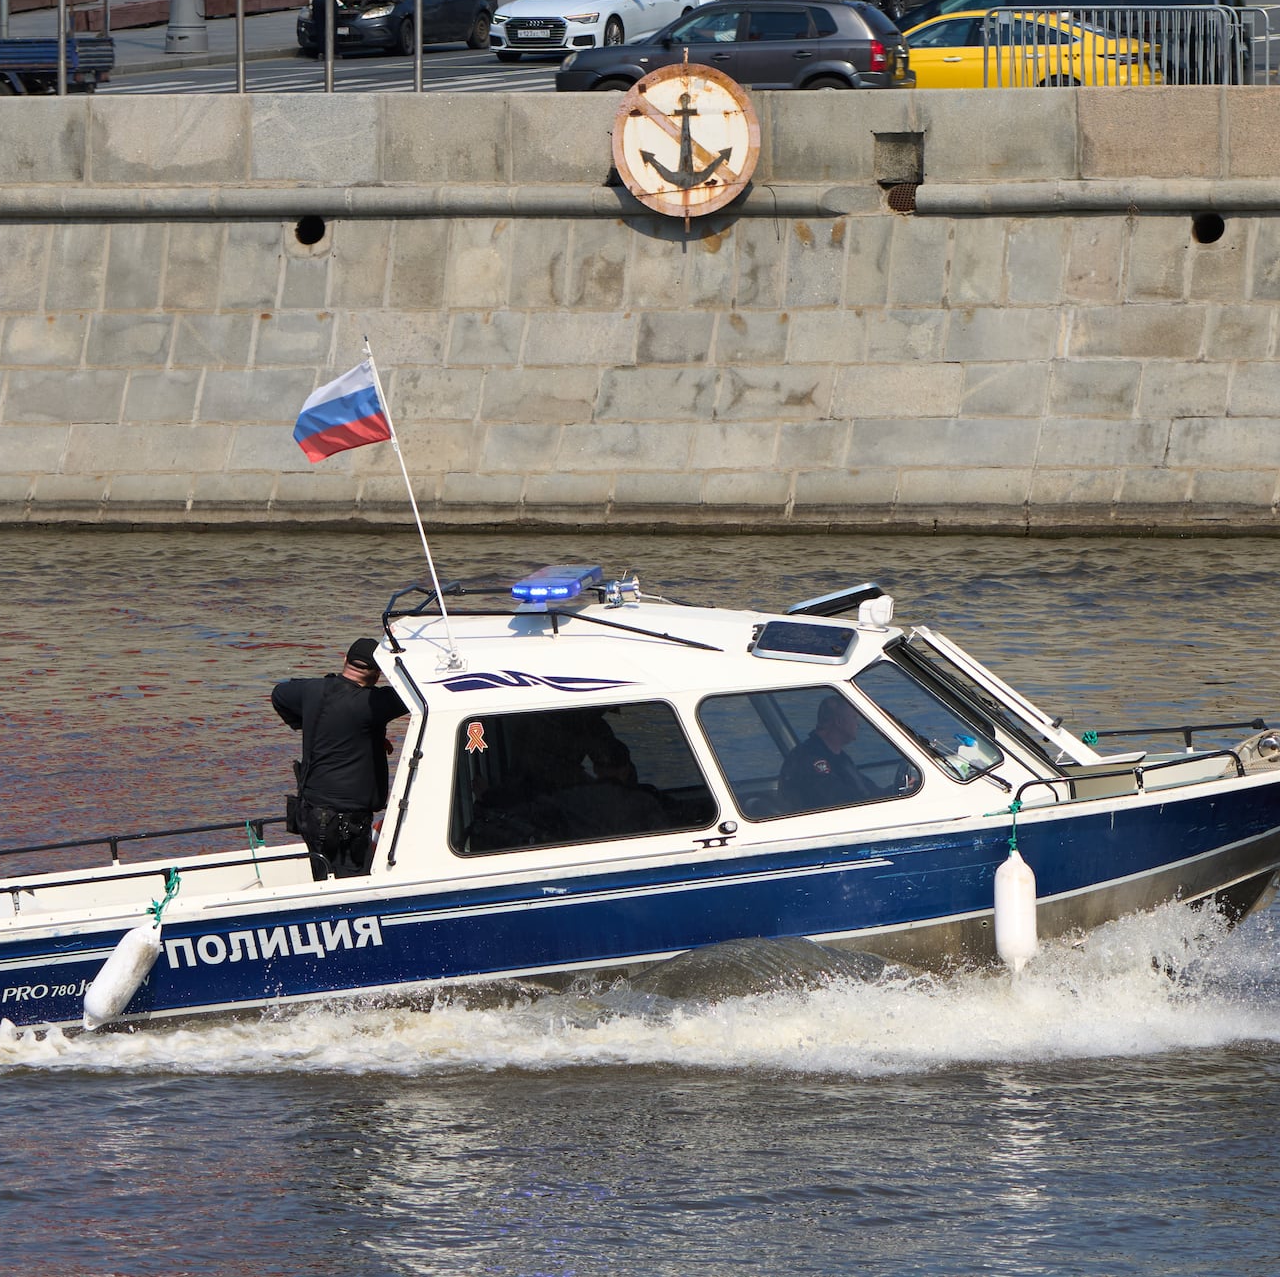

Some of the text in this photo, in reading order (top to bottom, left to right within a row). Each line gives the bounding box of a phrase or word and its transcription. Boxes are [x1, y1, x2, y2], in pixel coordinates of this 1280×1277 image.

[164, 915, 384, 970] ПОЛИЦИЯ
[2, 983, 49, 1004] PRO
[51, 984, 77, 998] 780
